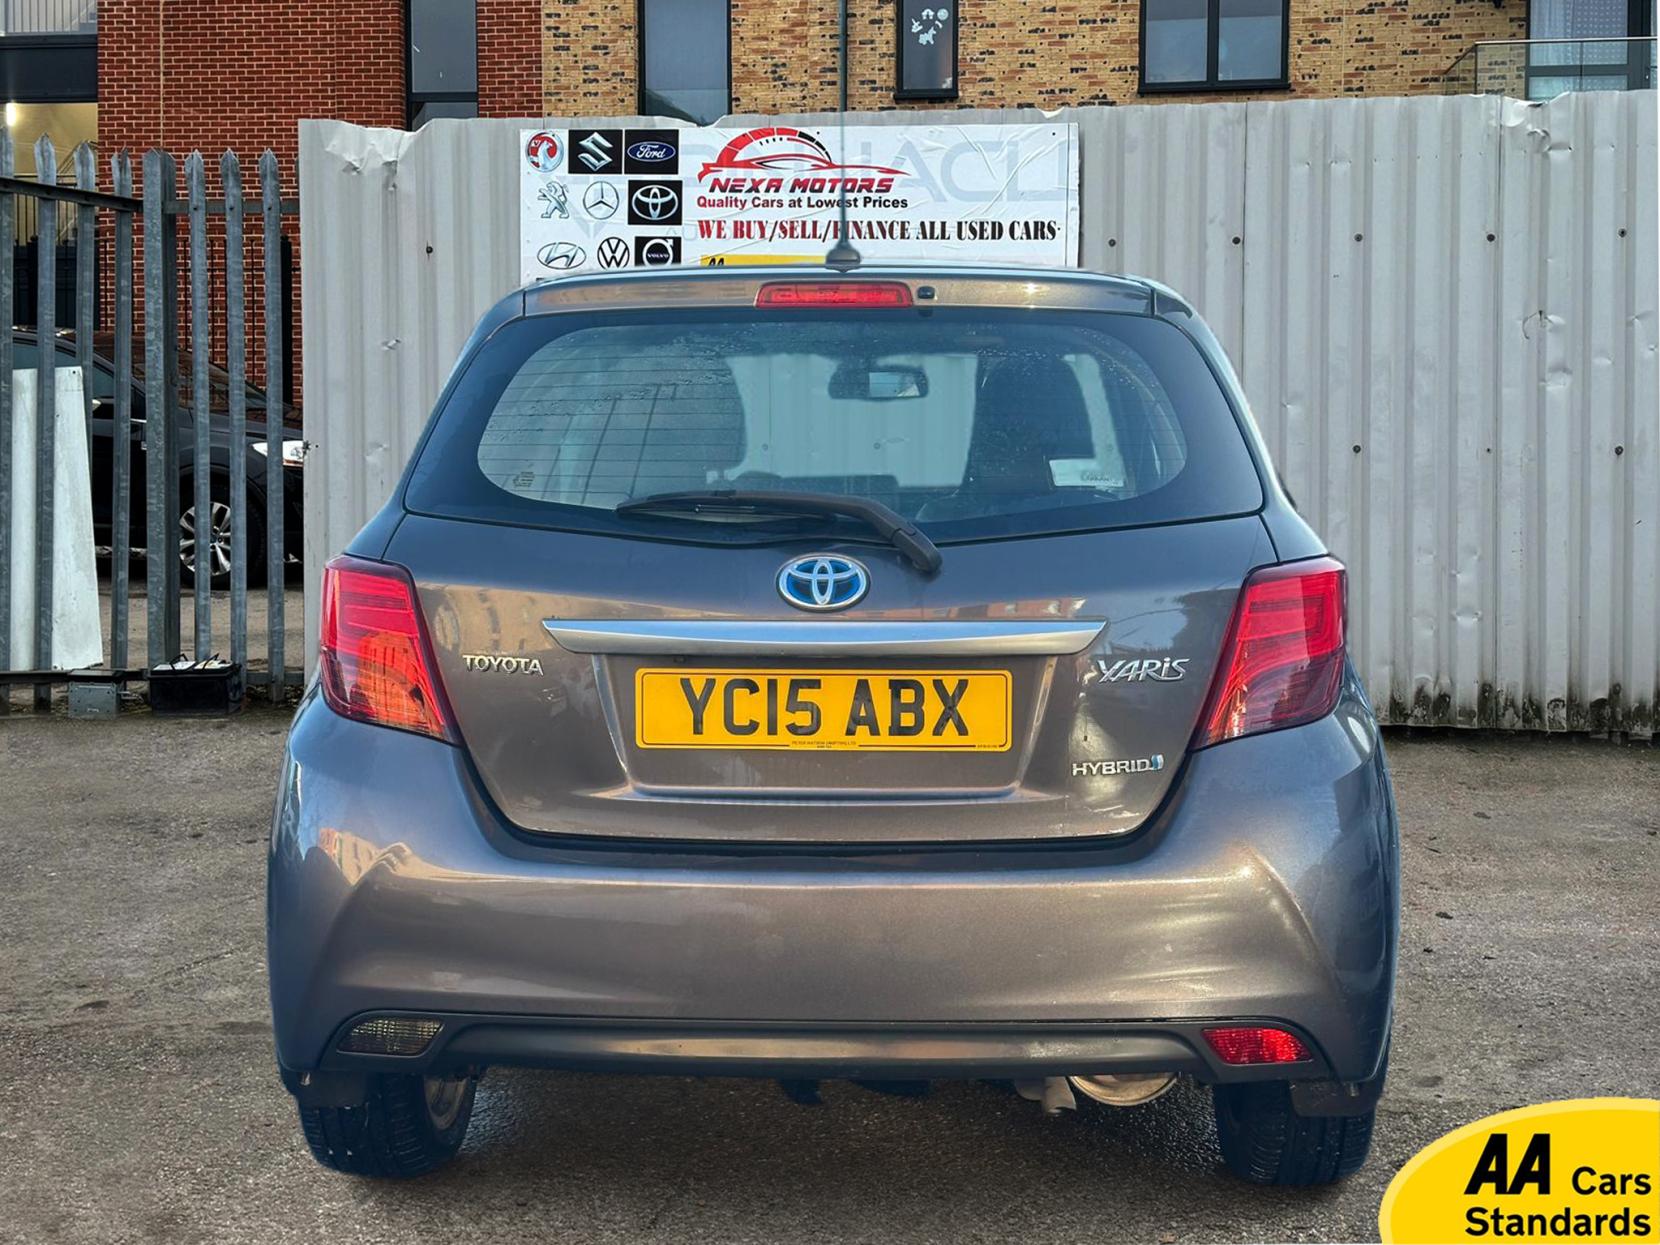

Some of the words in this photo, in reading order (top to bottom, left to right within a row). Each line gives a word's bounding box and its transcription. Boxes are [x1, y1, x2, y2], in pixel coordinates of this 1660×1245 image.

[636, 144, 666, 159] Ford
[709, 178, 784, 193] NEXA
[789, 178, 894, 193] MOTORS
[697, 195, 747, 210] Quality
[752, 196, 784, 208] Cars
[788, 197, 803, 208] at
[807, 196, 858, 208] Lowest
[863, 196, 908, 208] Prices
[697, 220, 726, 239] WE
[916, 220, 950, 240] ALL
[957, 220, 1003, 240] USED
[1009, 220, 1057, 240] CARS
[462, 655, 544, 676] TOYOTA
[680, 678, 822, 736] YC15
[845, 678, 969, 737] ABX
[1072, 758, 1152, 777] HYBRID
